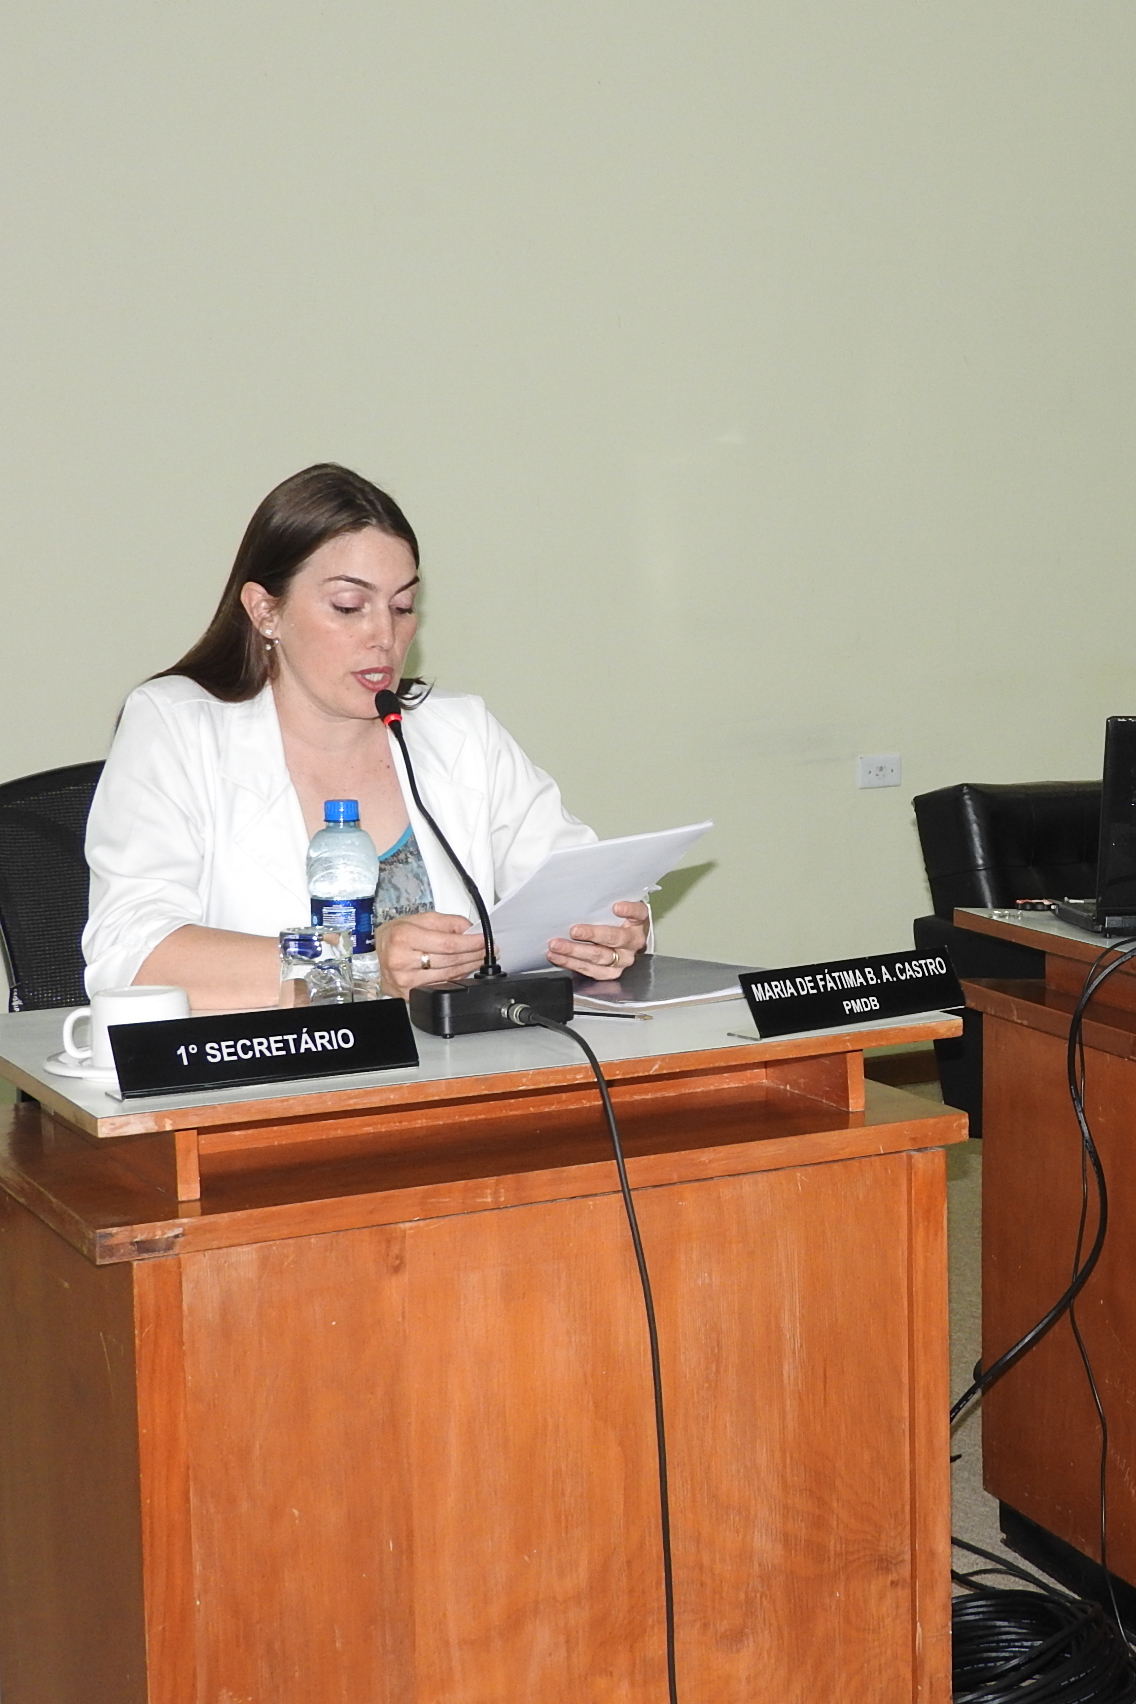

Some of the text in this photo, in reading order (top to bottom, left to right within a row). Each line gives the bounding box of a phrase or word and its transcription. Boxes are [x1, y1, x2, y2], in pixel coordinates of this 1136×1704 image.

[751, 957, 947, 1002] MARIA DE FÁTIMA B. A. CASTRO
[842, 996, 880, 1014] PMDB
[205, 1028, 355, 1063] SECRETÁRIO
